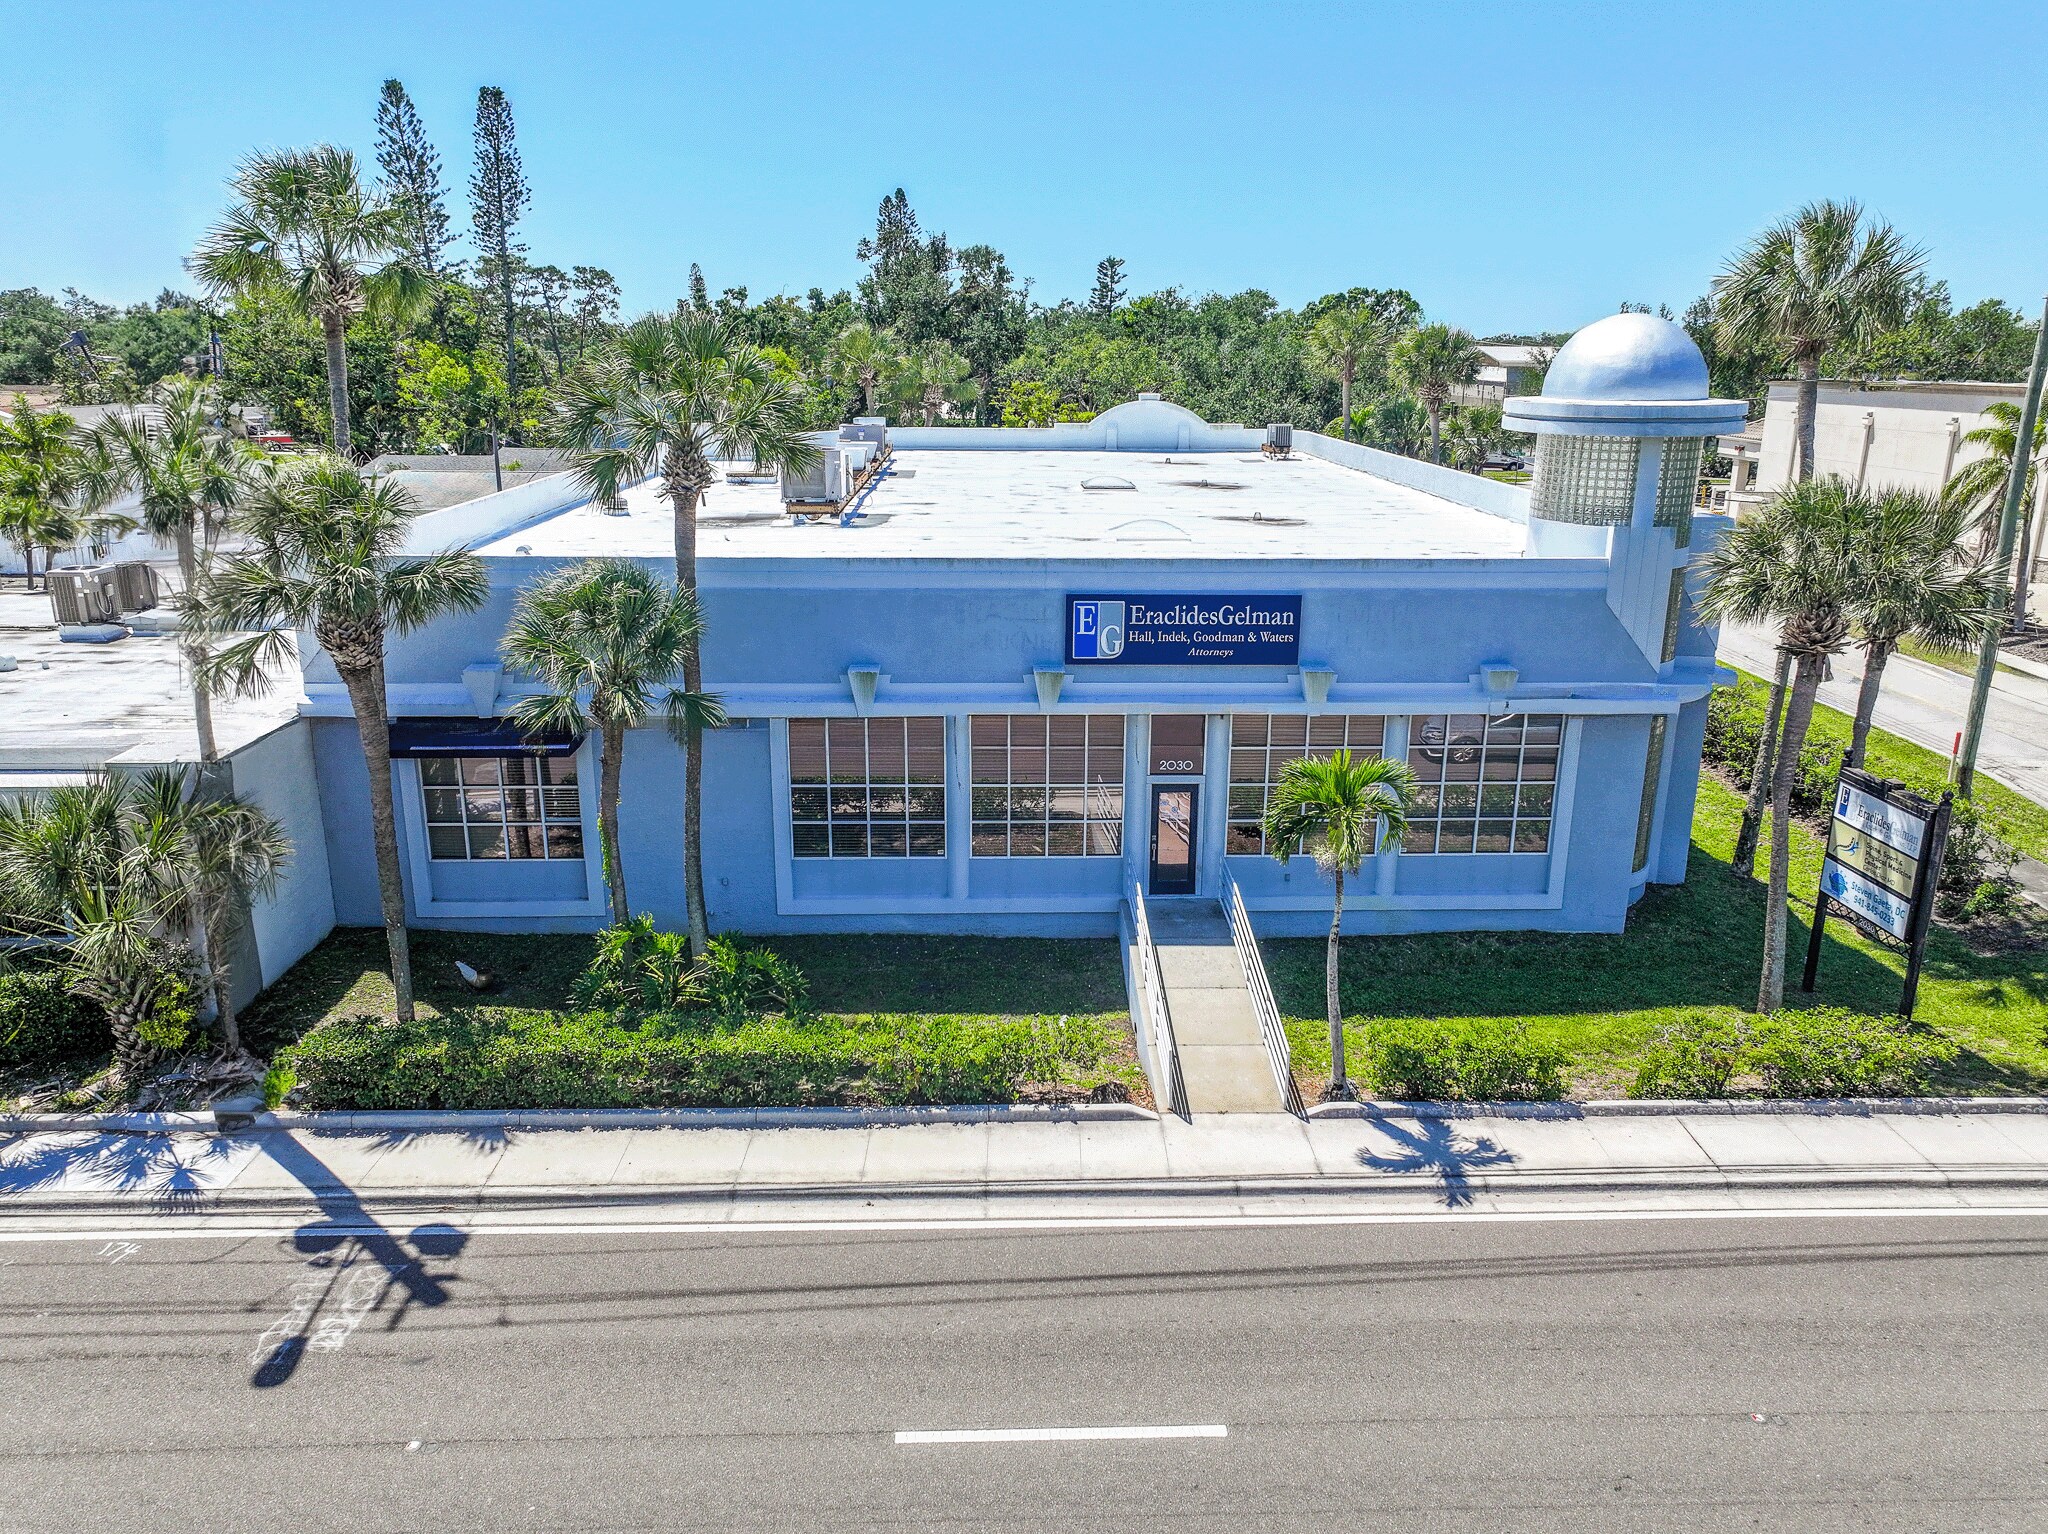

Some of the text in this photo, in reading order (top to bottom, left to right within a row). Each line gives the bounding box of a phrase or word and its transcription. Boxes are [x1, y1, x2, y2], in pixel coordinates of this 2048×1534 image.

[1077, 605, 1095, 635] E
[1130, 605, 1294, 626] EraclidesGelman
[1101, 625, 1121, 655] G
[1129, 631, 1294, 644] Hall, Indek, Goodman & Waters
[1188, 648, 1233, 658] Attorneys
[1159, 760, 1194, 771] 2030
[1850, 880, 1872, 900] Steven
[1873, 893, 1893, 914] Gaeta,
[1895, 906, 1905, 919] DC
